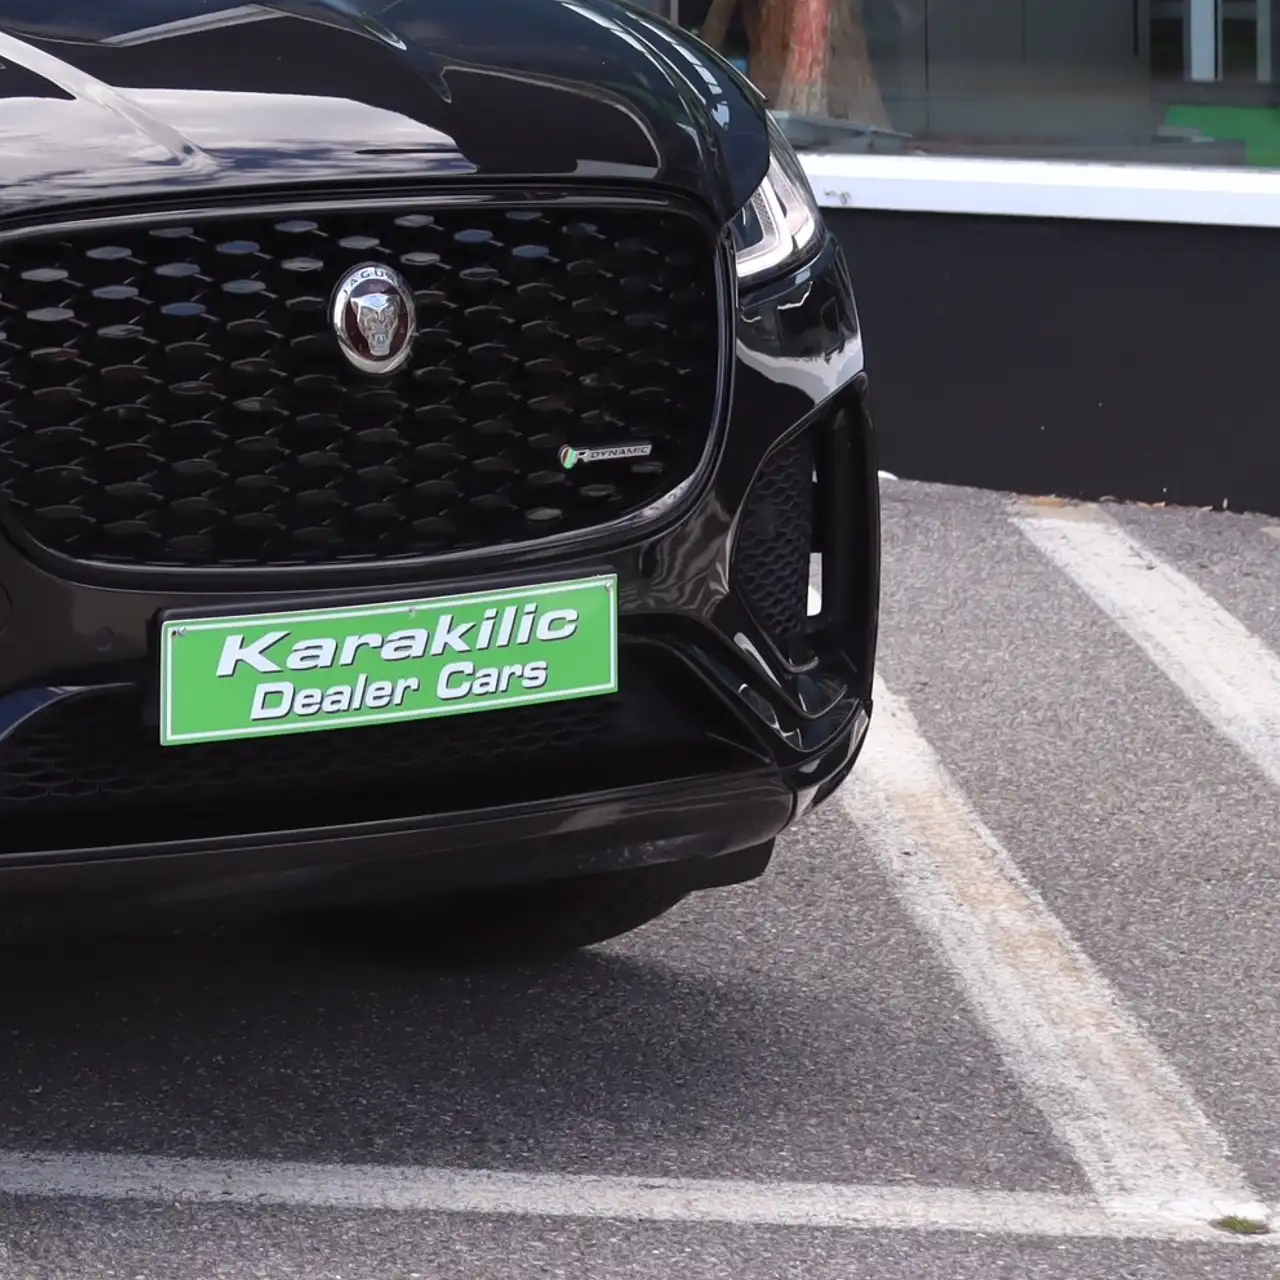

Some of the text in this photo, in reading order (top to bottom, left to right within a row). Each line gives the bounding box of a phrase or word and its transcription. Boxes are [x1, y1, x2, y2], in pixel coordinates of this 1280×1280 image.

[216, 603, 580, 678] Karakilic
[249, 660, 549, 721] Dealer Cars
